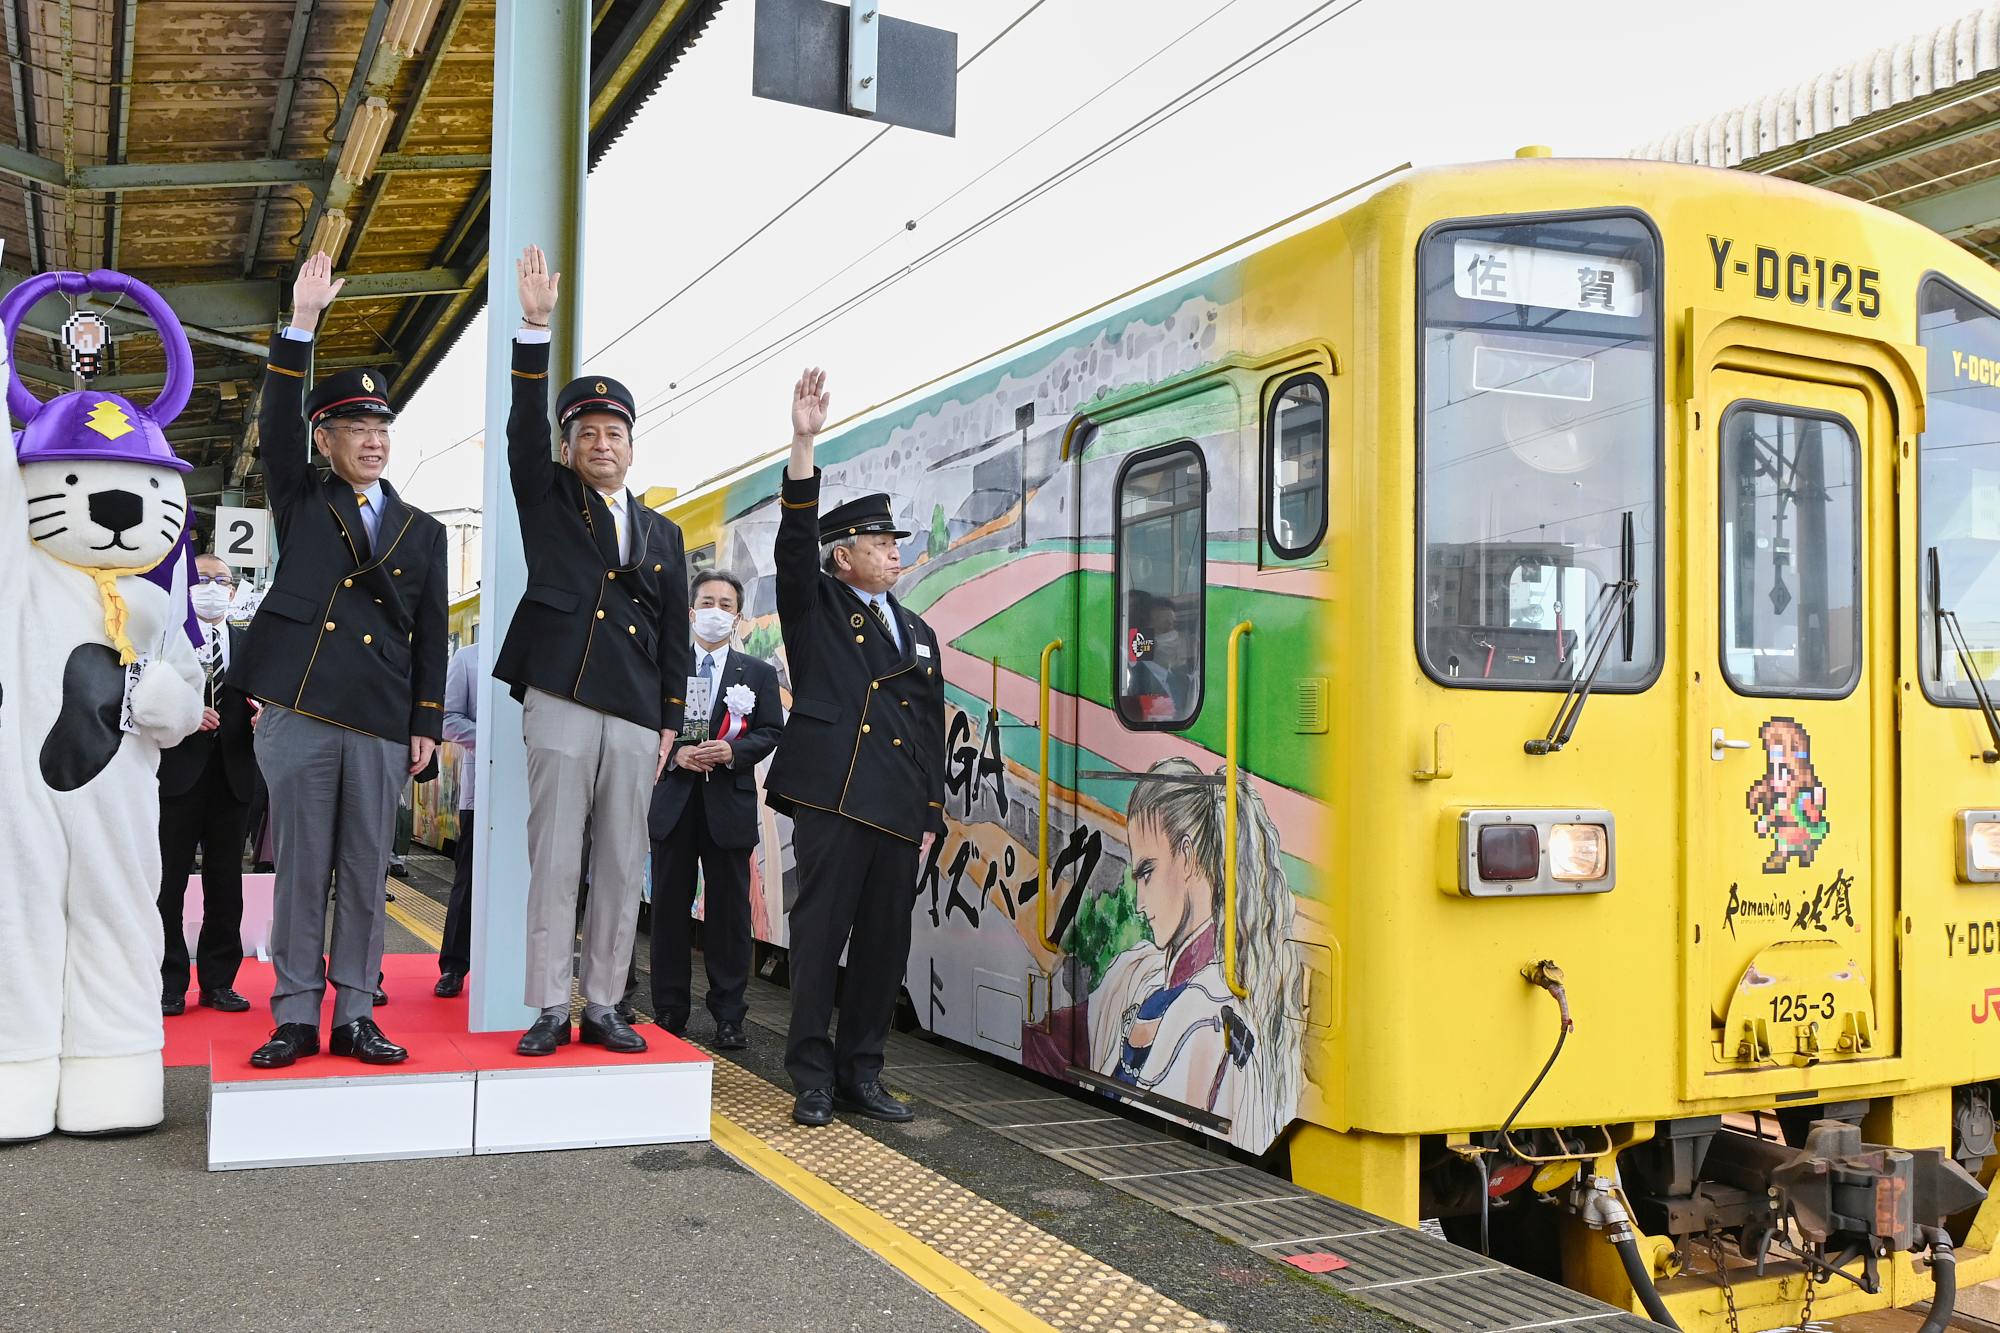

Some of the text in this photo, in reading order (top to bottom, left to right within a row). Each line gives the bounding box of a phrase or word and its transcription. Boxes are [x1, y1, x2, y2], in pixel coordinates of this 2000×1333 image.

[1467, 253, 1616, 312] 佐賀
[1706, 234, 1881, 321] Y-DC125
[228, 520, 254, 555] 2
[1722, 882, 1791, 941] Romancing
[1769, 992, 1835, 1022] 125-3
